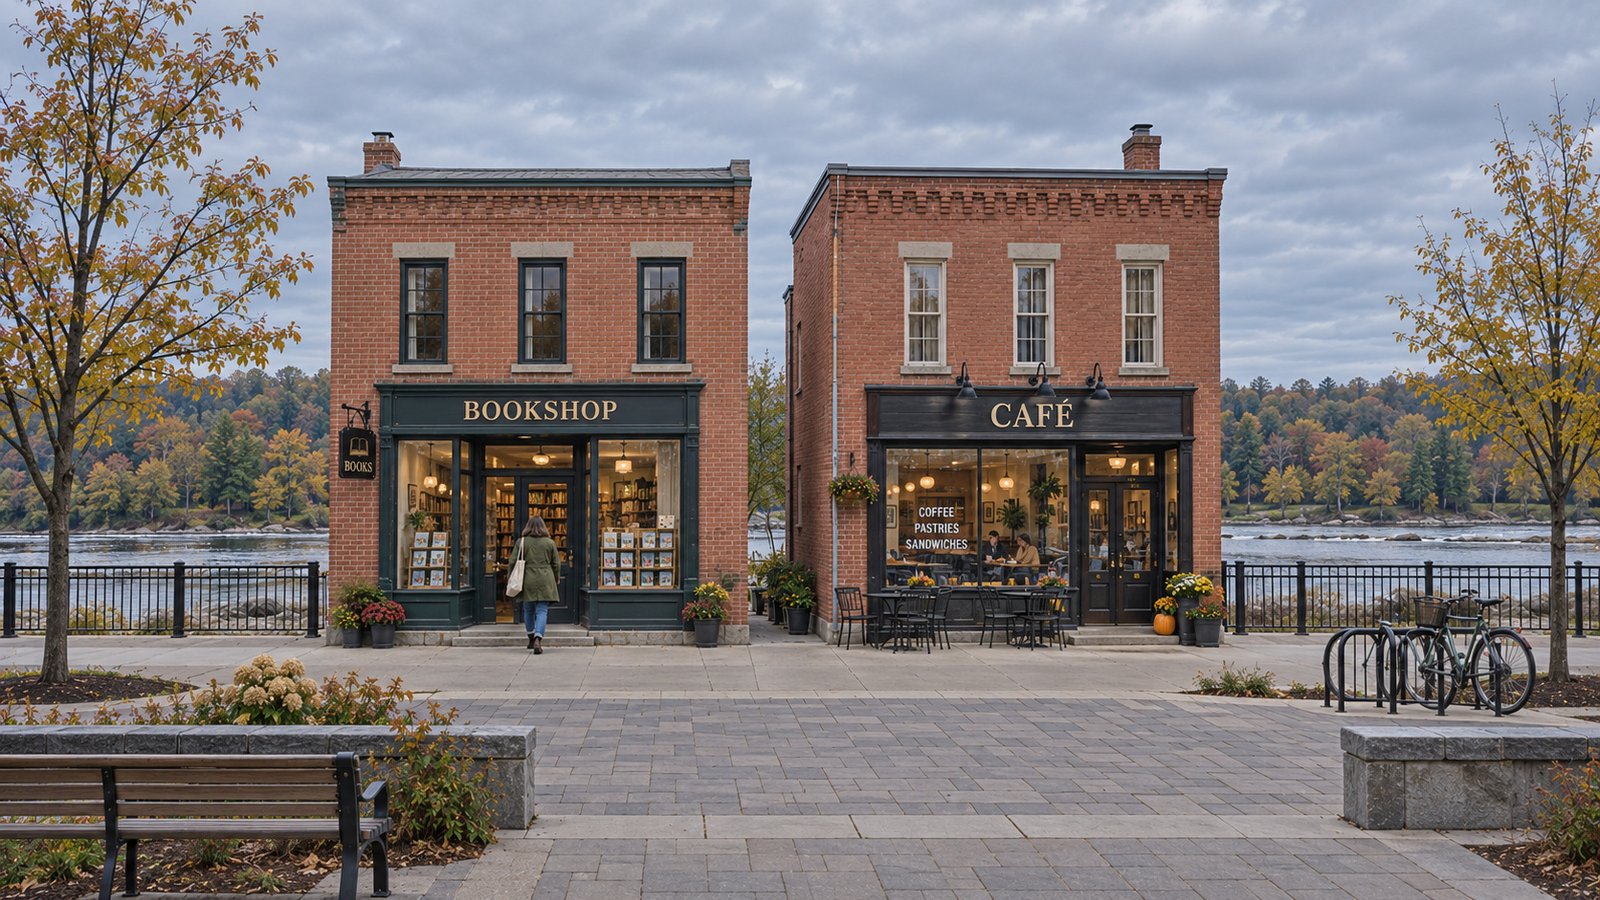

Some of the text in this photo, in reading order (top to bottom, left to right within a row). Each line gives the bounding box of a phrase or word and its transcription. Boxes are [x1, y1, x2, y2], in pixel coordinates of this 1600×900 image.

[463, 400, 618, 421] BOOKSHOP
[990, 398, 1074, 428] CAFÉ
[344, 461, 373, 473] BOOKS
[919, 507, 955, 517] COFFEE
[915, 523, 959, 533] PASTRIES
[906, 539, 968, 549] SANDWICHES
